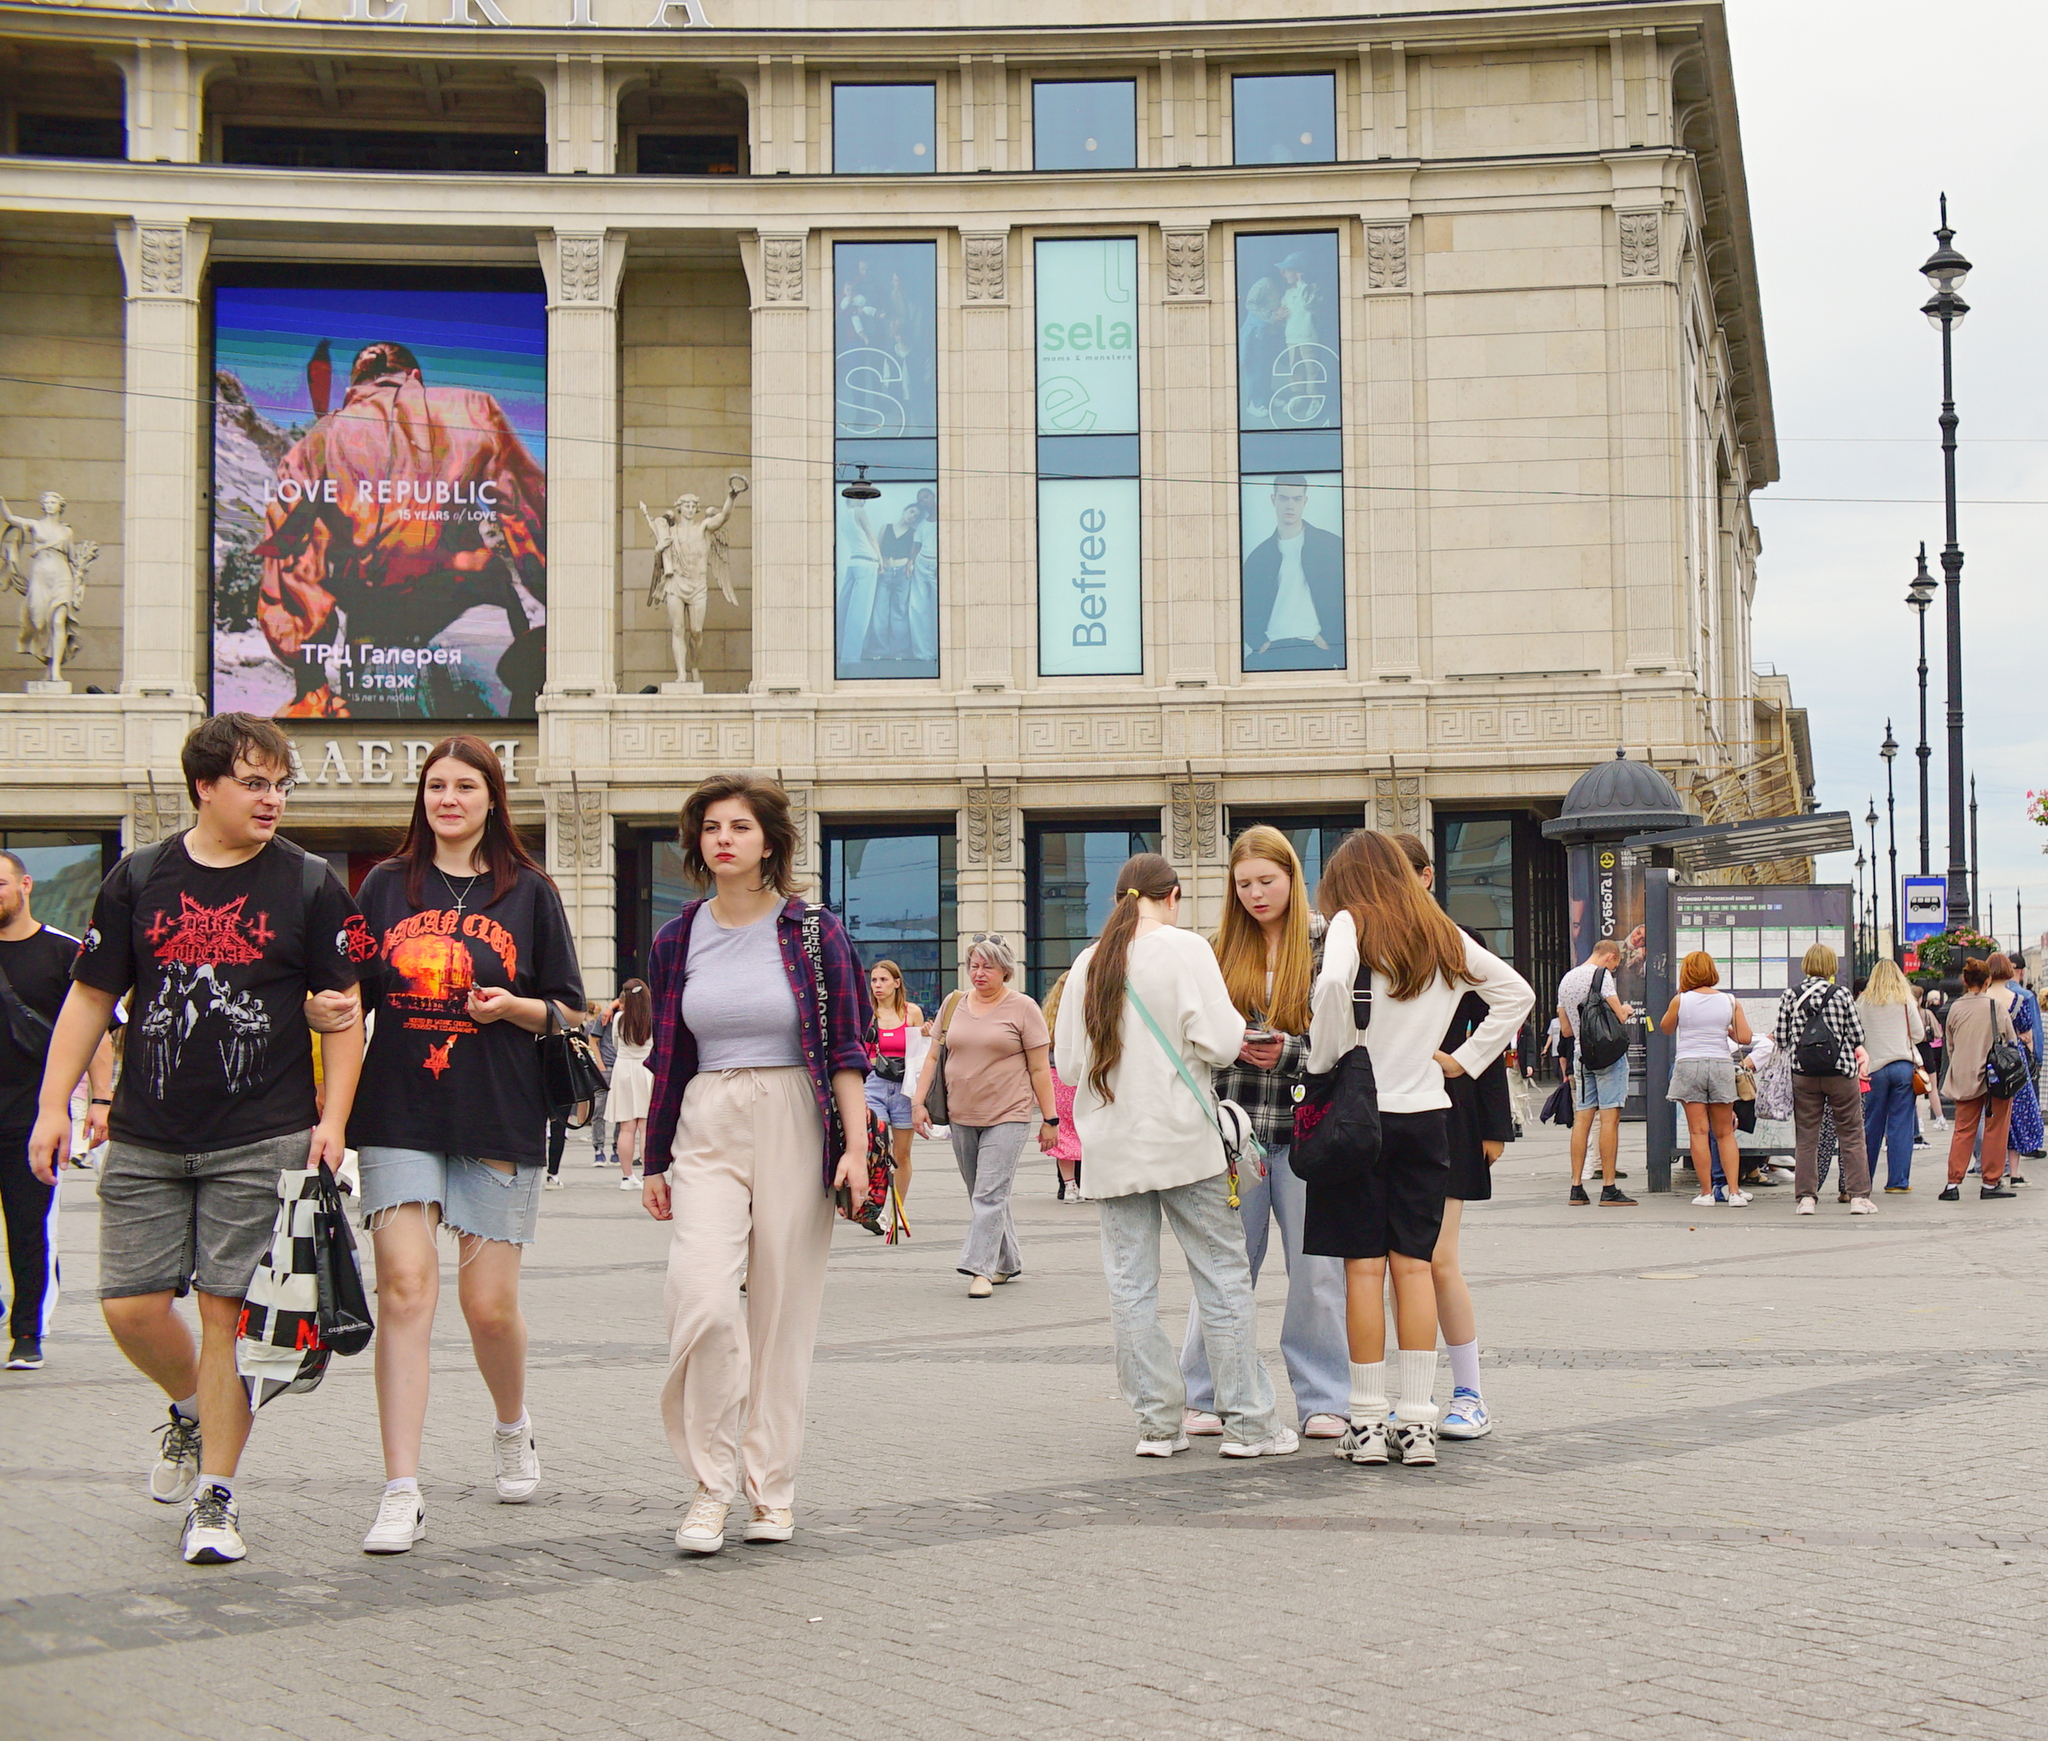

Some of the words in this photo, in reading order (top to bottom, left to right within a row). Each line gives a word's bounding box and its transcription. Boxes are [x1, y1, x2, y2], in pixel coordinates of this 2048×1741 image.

[1043, 314, 1132, 351] sela
[263, 478, 338, 504] LOVE
[358, 479, 498, 504] REPUBLIC
[398, 509, 411, 521] 15
[414, 510, 450, 521] YEARS
[453, 508, 466, 524] of
[467, 510, 498, 521] LOVE
[1072, 508, 1107, 647] Befree
[300, 643, 352, 668] ТРЦ
[360, 643, 462, 669] Галерея
[346, 672, 355, 689] 1
[361, 674, 415, 689] этаж
[1601, 878, 1616, 937] Суббота
